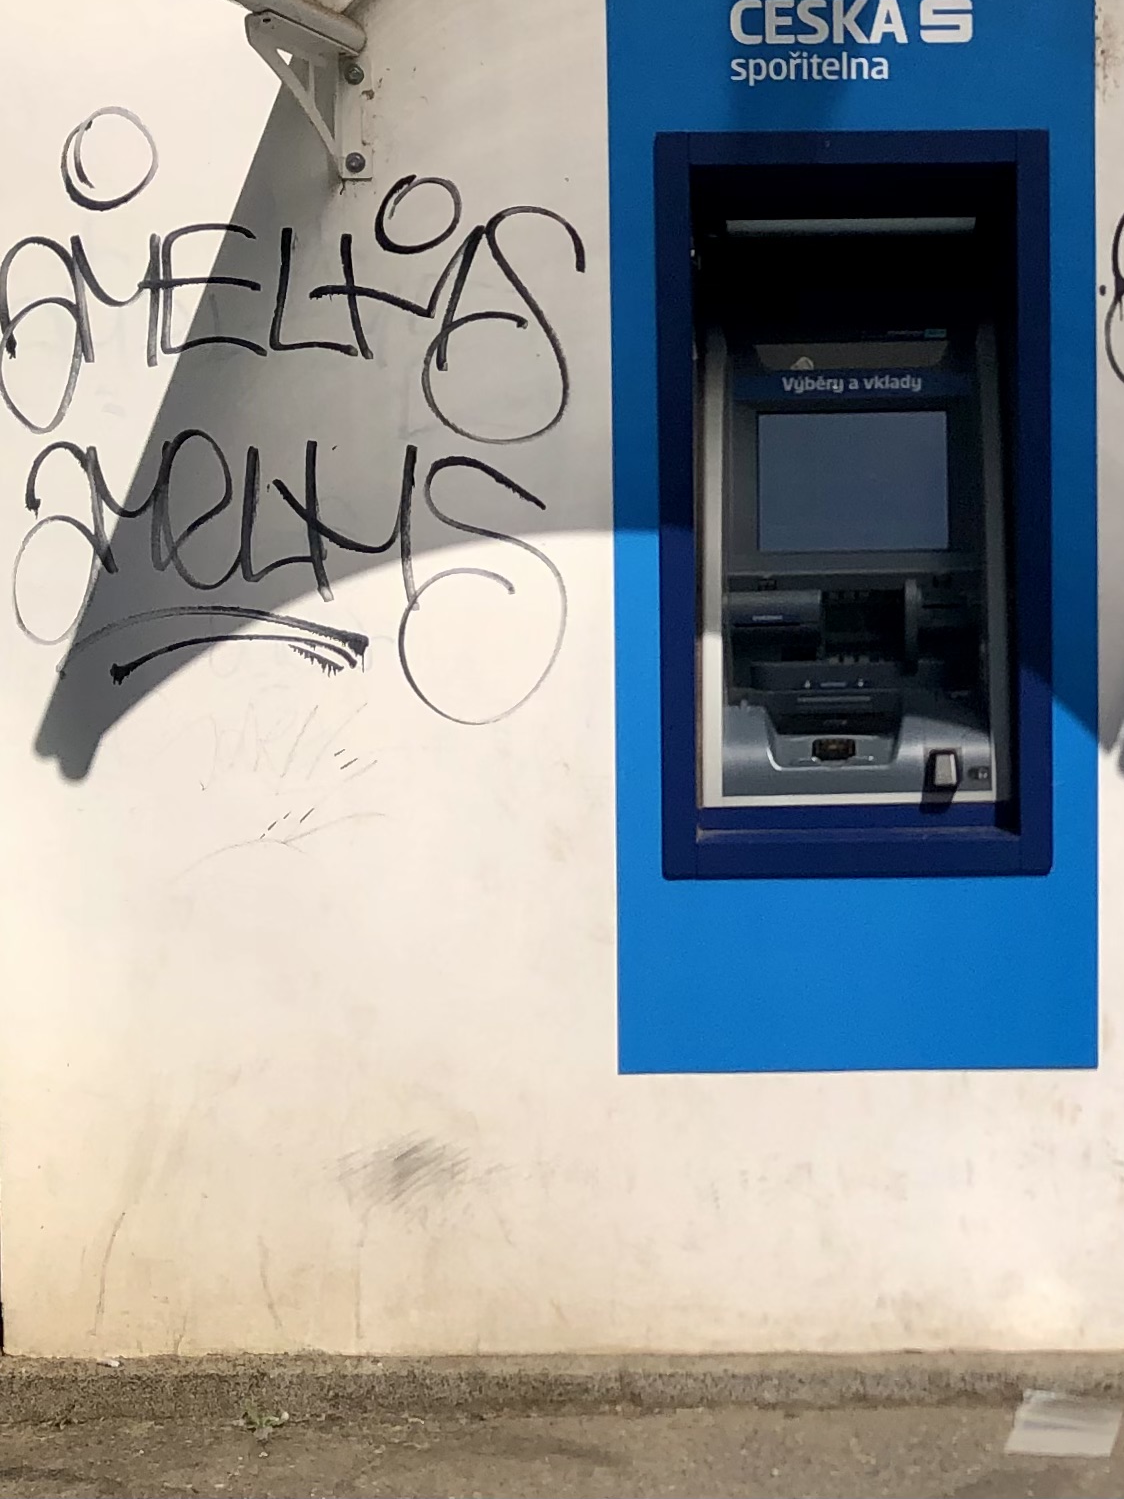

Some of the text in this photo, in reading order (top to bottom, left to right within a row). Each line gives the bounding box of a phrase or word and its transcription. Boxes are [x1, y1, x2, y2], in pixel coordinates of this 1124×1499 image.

[730, 51, 889, 86] spořitelna
[848, 378, 860, 390] a
[863, 374, 922, 393] vklady
